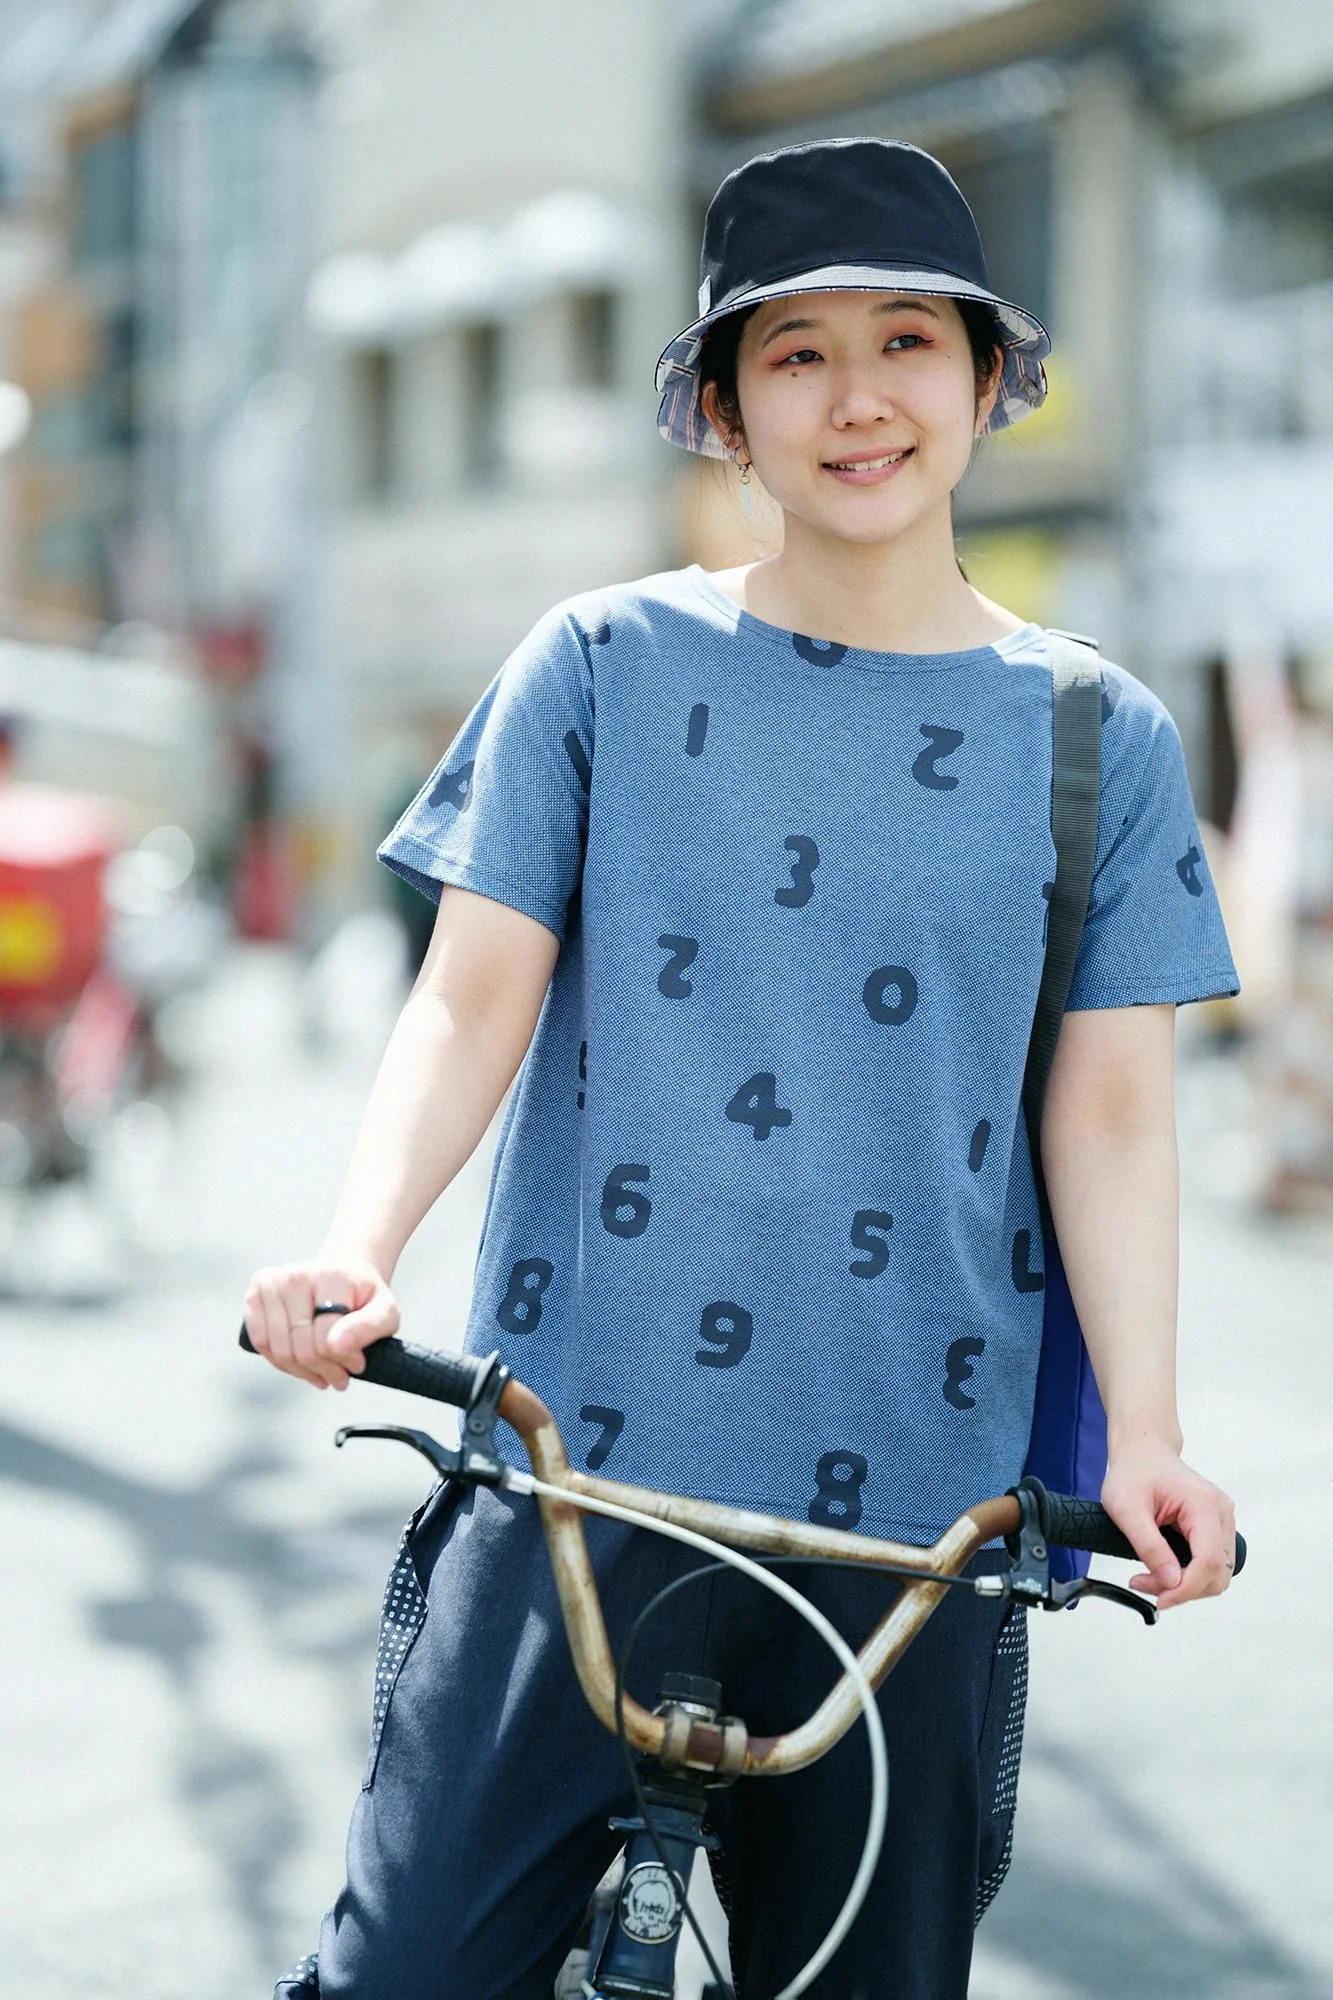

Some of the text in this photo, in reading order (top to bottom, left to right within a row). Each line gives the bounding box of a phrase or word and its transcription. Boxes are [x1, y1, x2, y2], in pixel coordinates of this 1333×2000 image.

[687, 705, 707, 756] 1
[914, 726, 963, 789] 2
[776, 837, 819, 907] 3
[659, 935, 698, 998] 2
[863, 967, 917, 1025] 0
[727, 1073, 791, 1140] 4
[969, 1120, 991, 1171] 1
[601, 1164, 651, 1238] 6
[851, 1211, 893, 1278] 5
[498, 1259, 553, 1334] 8
[696, 1302, 752, 1367] 9
[581, 1406, 623, 1469] 7
[808, 1451, 866, 1529] 8
